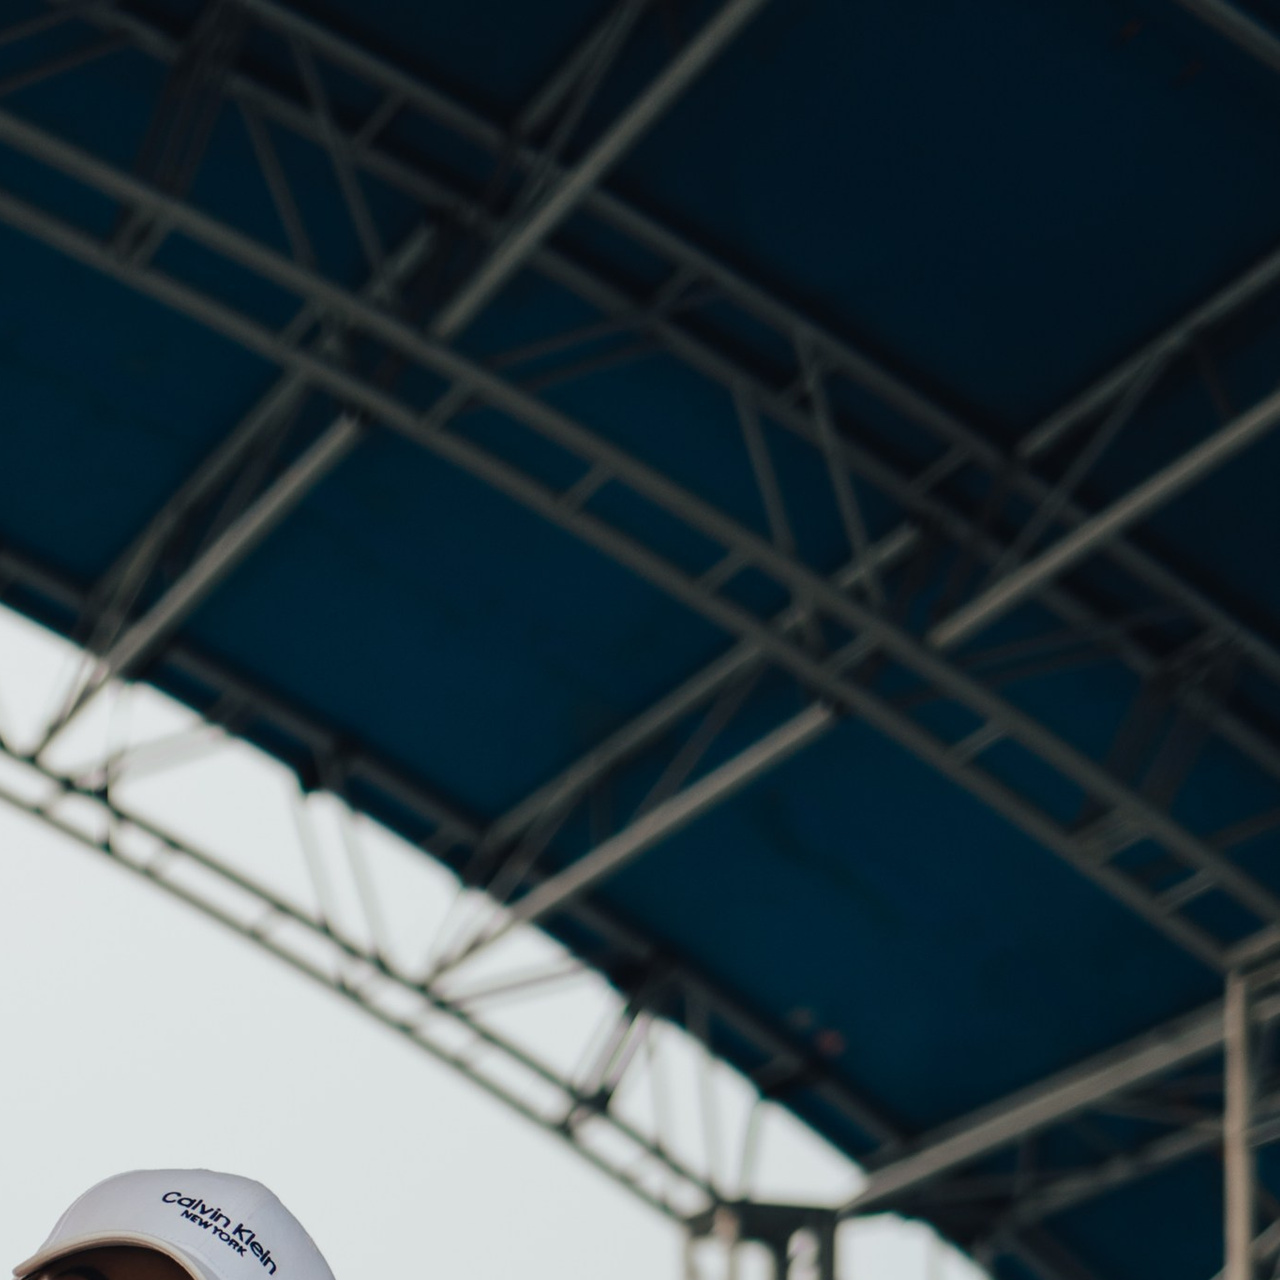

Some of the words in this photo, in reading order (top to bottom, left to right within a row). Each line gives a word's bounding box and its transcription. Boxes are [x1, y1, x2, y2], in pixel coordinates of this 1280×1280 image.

[161, 1191, 231, 1229] Calvin
[232, 1223, 277, 1276] Klein
[180, 1209, 213, 1230] NEW
[212, 1225, 248, 1257] YORK
